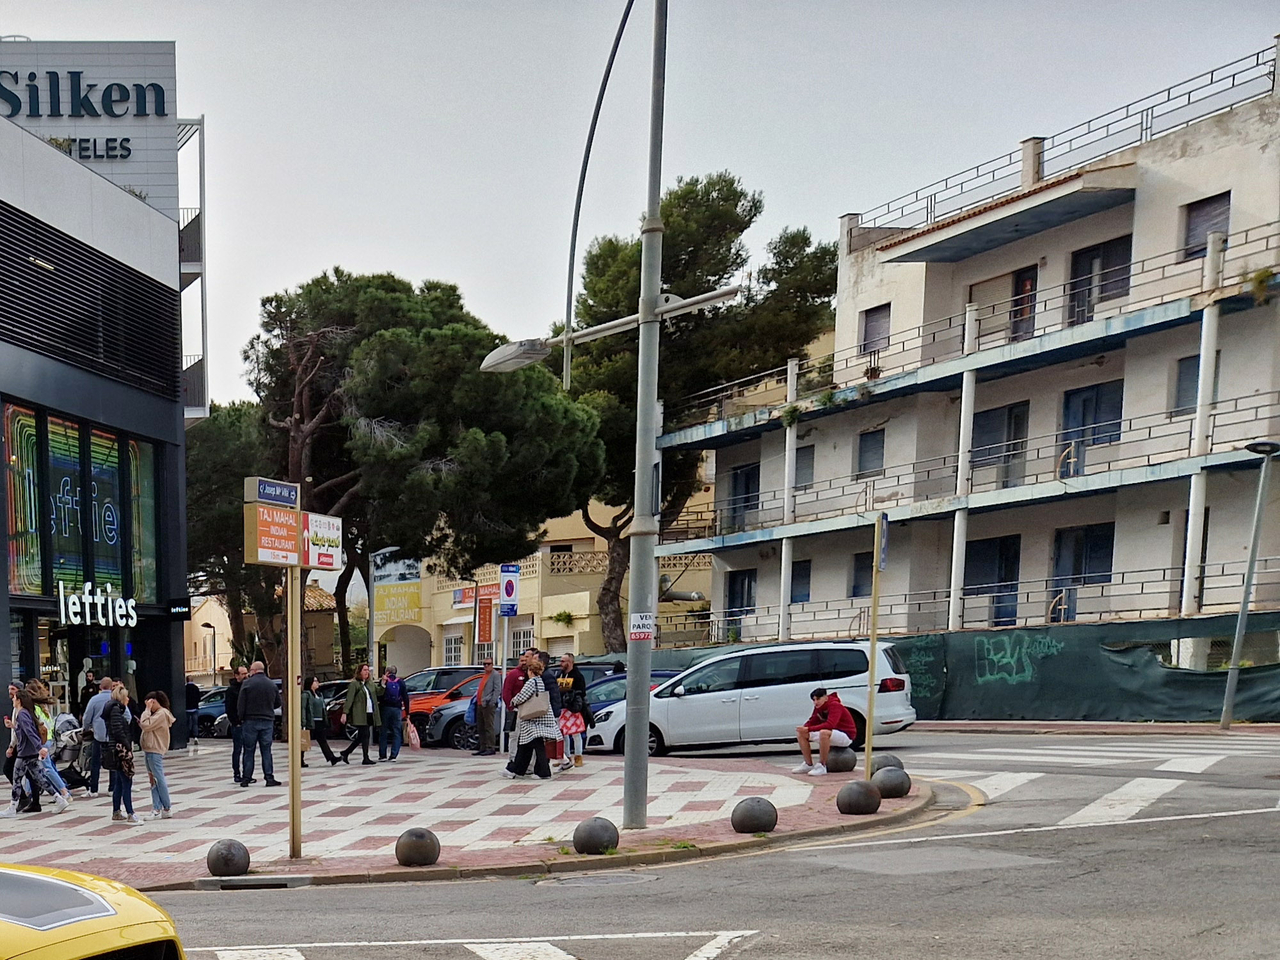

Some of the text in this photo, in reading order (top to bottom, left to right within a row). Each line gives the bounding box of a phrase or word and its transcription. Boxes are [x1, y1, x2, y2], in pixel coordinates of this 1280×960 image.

[70, 137, 132, 160] TELES
[259, 508, 297, 526] TAJ MAHAL
[270, 526, 287, 537] INDIAN
[261, 536, 295, 551] RESTAURANT
[390, 585, 420, 594] MAHAL
[58, 580, 138, 628] lefties
